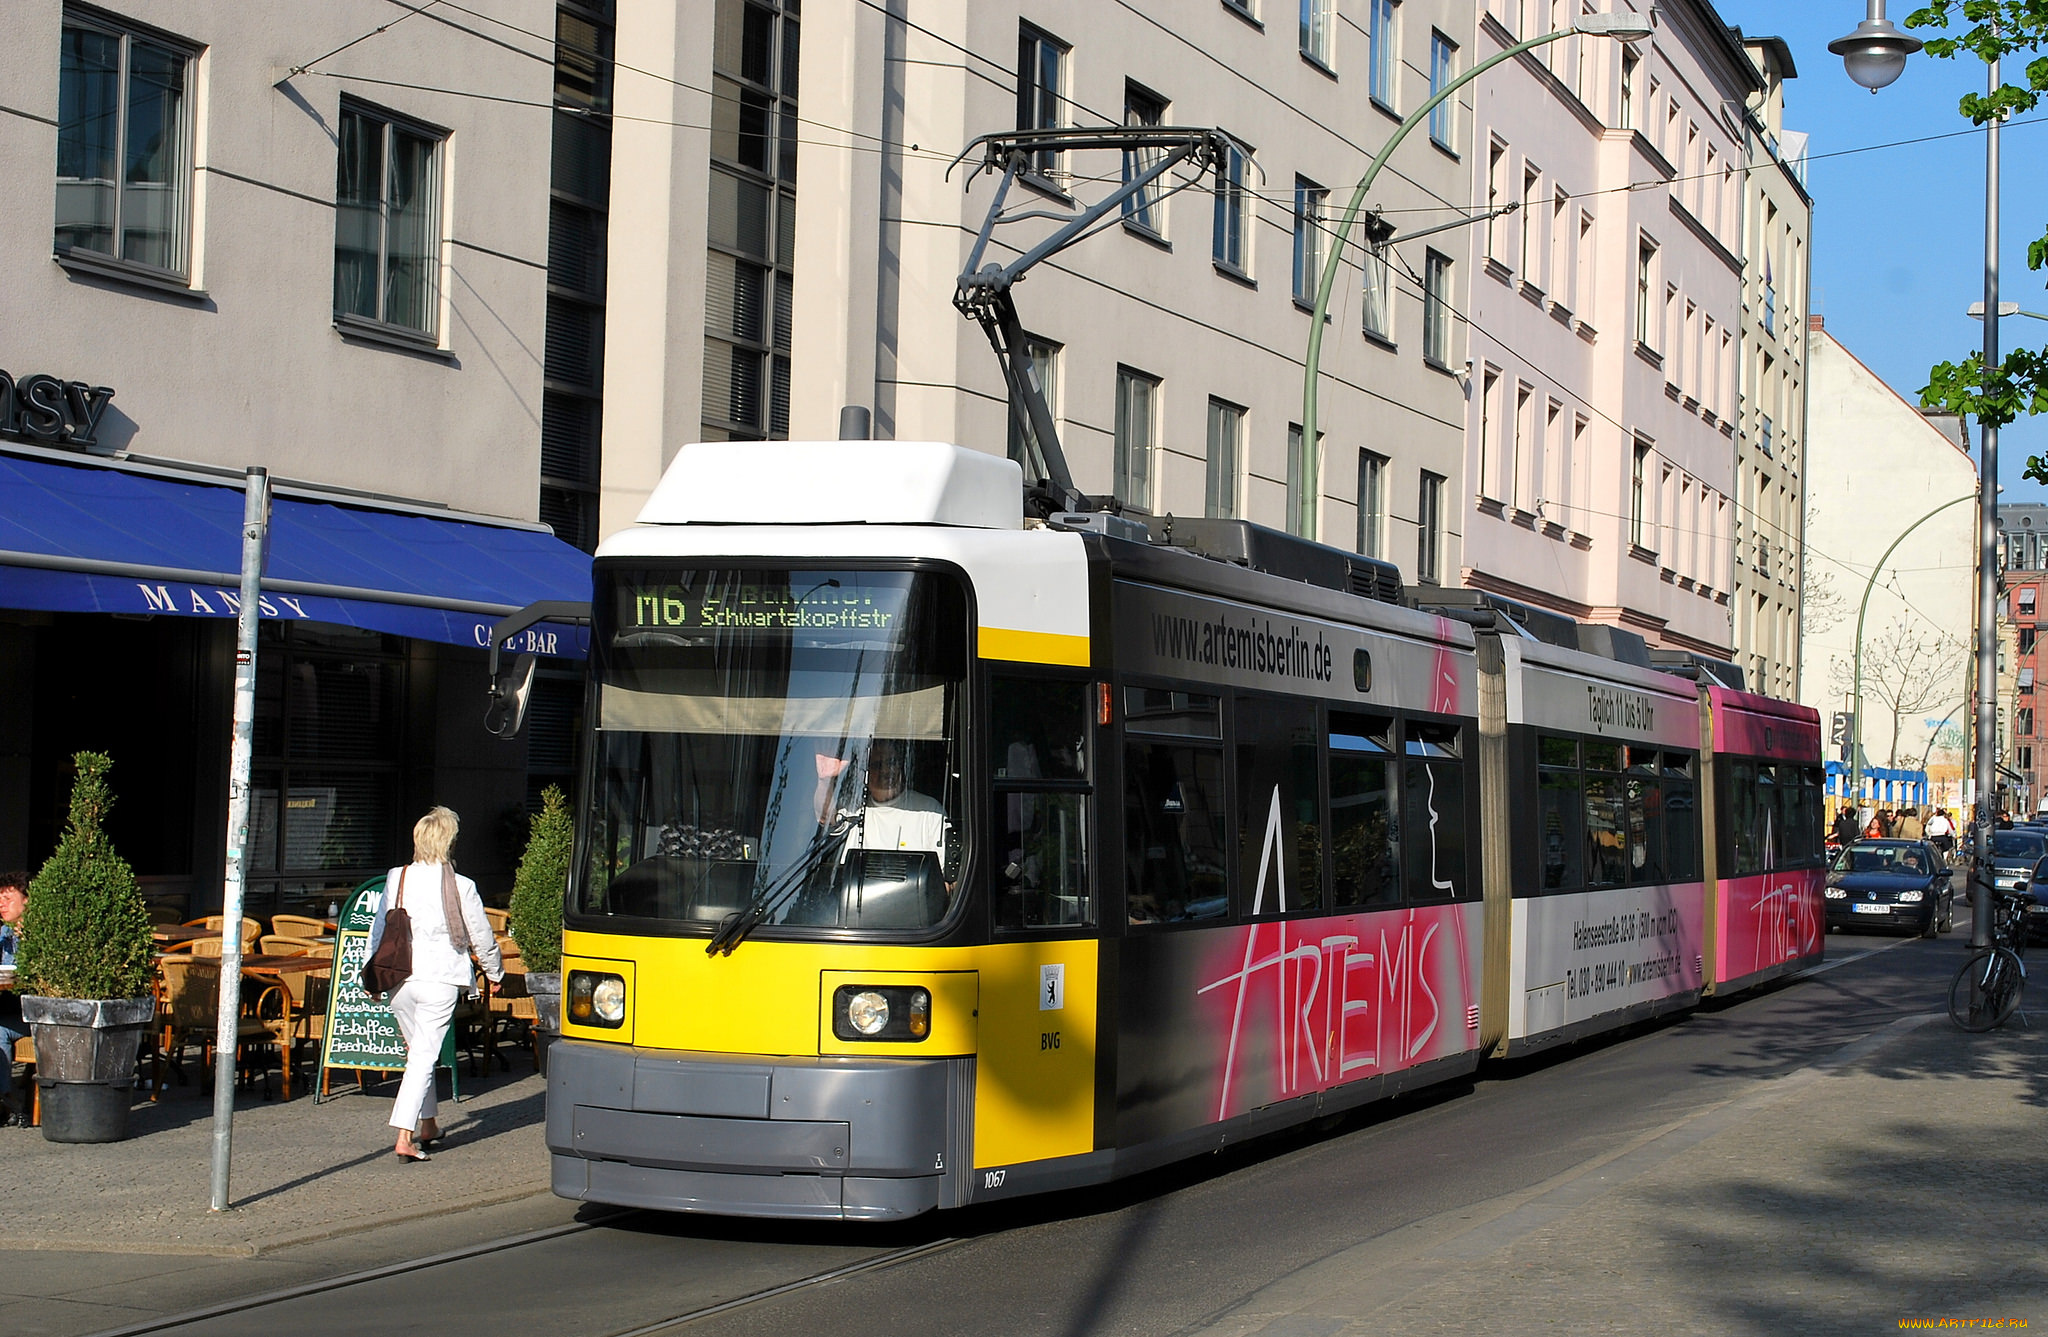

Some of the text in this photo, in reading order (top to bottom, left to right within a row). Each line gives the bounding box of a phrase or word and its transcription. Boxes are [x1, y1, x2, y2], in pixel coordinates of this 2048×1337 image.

[636, 586, 686, 626] M6
[700, 607, 893, 628] Schwartzkopffstr
[474, 623, 557, 654] CAE BAR
[1151, 613, 1331, 682] www.artemisberlin.de
[1197, 784, 1440, 1121] ARTEMIS
[1041, 1031, 1060, 1050] BVG
[984, 1170, 1006, 1189] 1067
